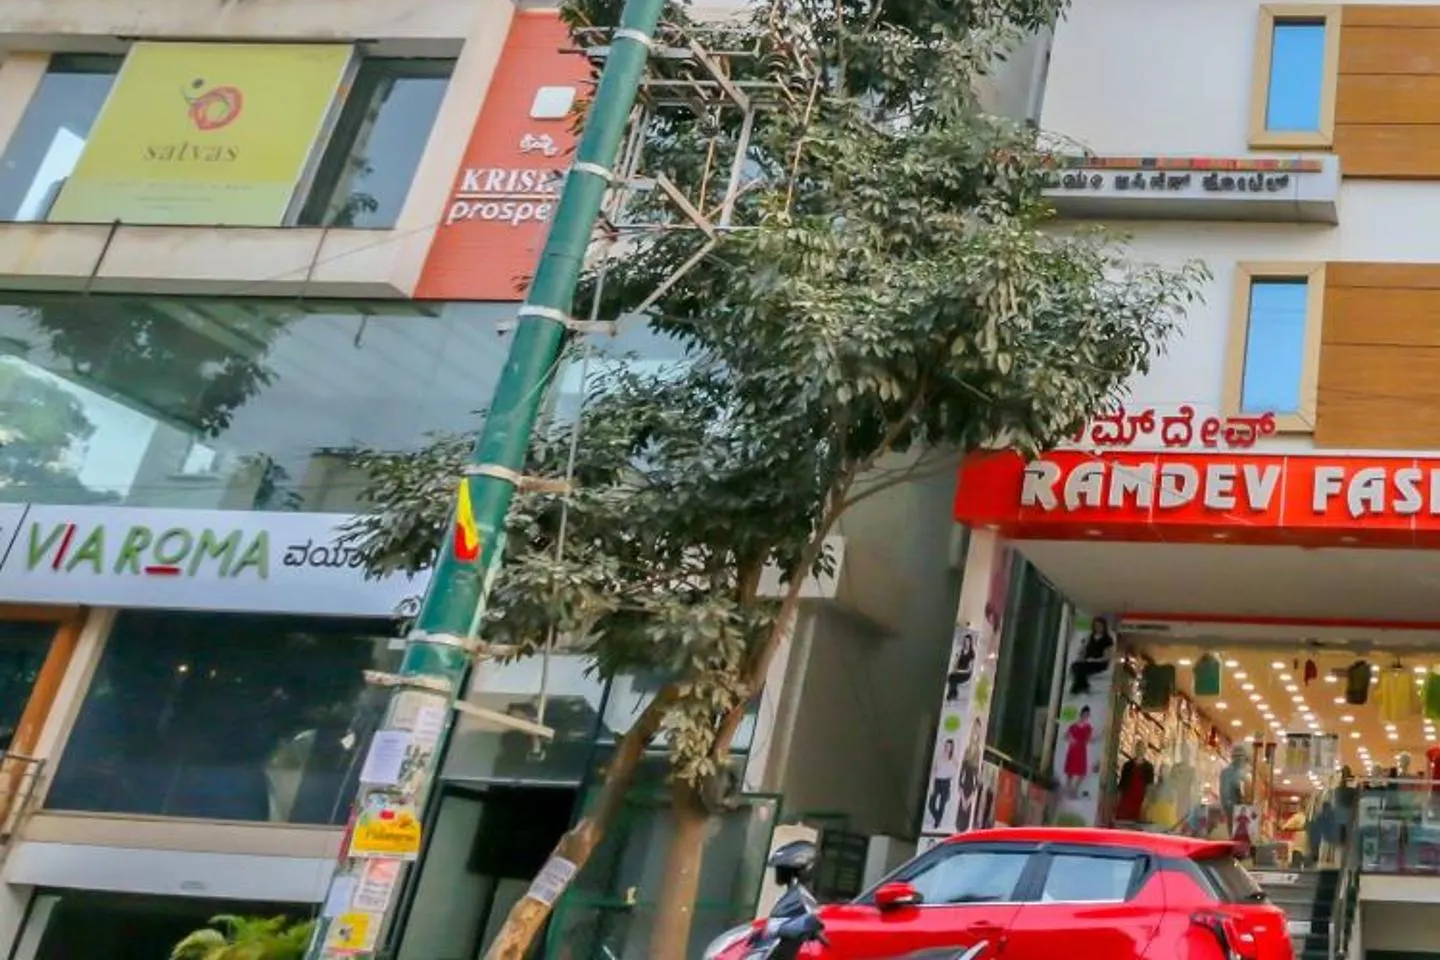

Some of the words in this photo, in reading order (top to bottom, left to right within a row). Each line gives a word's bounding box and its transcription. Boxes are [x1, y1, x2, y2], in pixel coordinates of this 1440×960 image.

[1020, 459, 1282, 512] RAMDEV
[26, 521, 105, 573] VIA
[113, 524, 271, 581] ROMA
